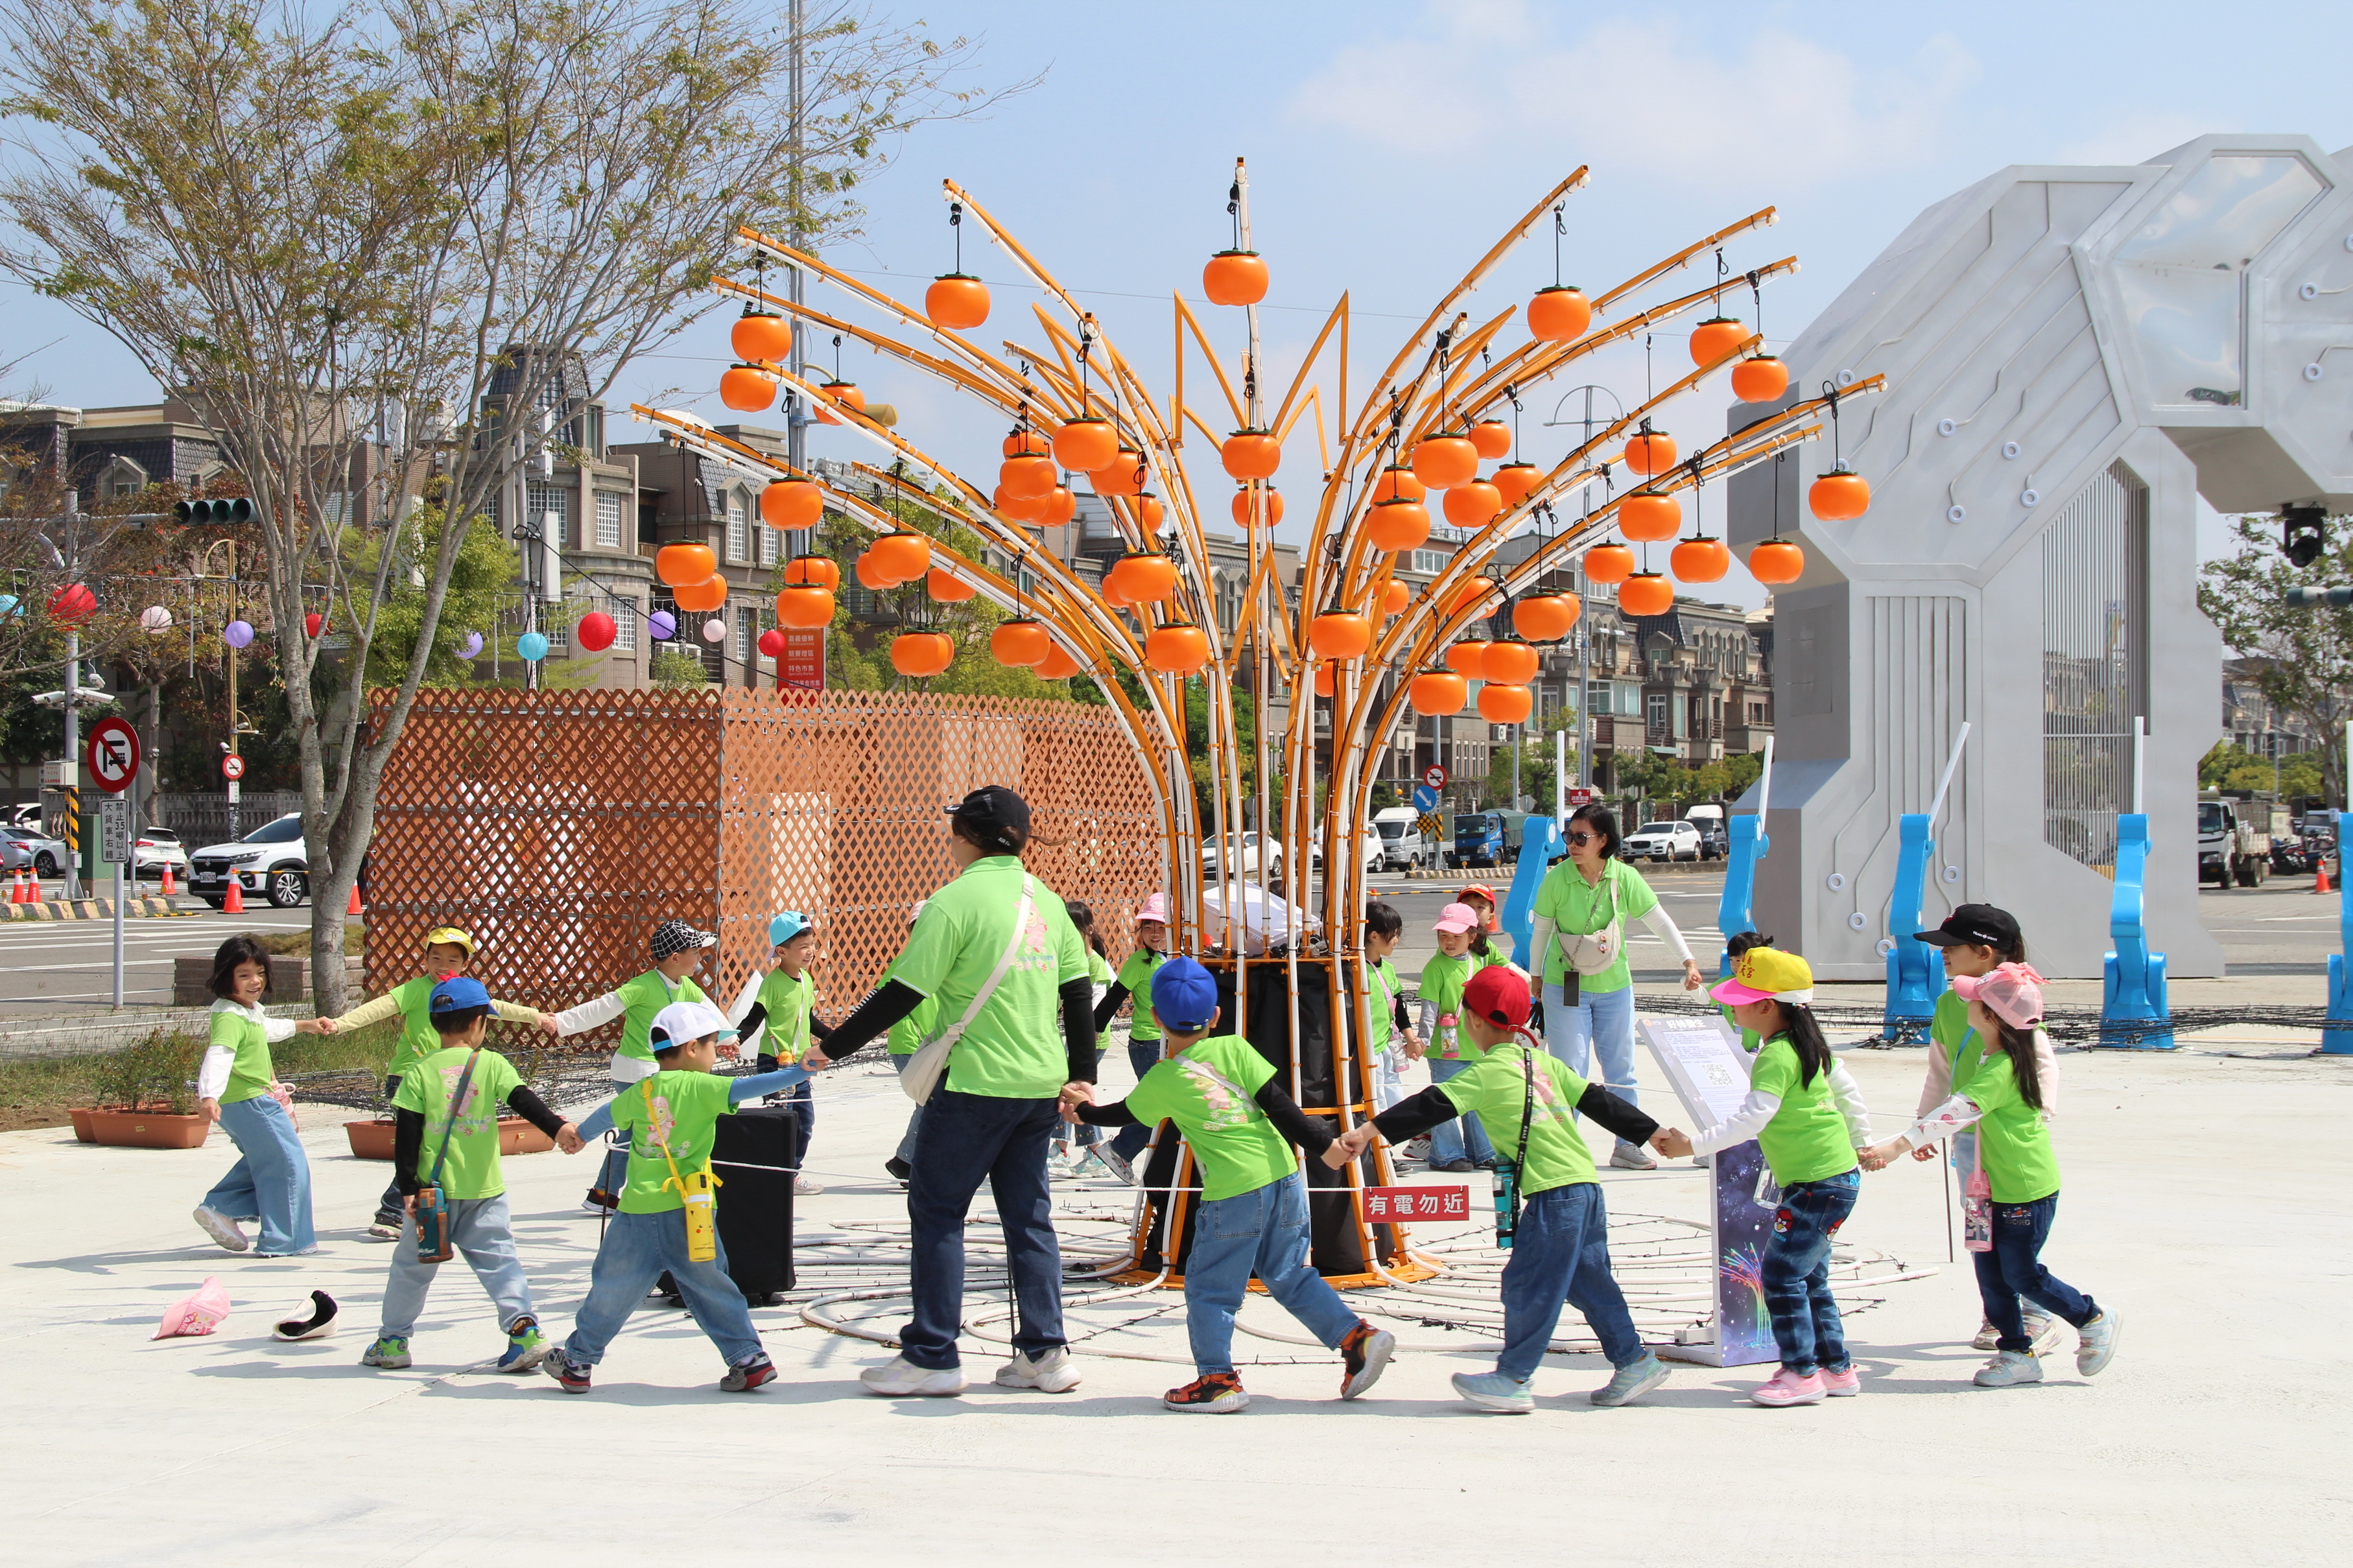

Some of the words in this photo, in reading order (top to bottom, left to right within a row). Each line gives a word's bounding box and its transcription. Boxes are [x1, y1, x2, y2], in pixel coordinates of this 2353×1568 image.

[105, 803, 113, 860] 大貨車右轉
[1368, 1193, 1464, 1215] 有電勿近
